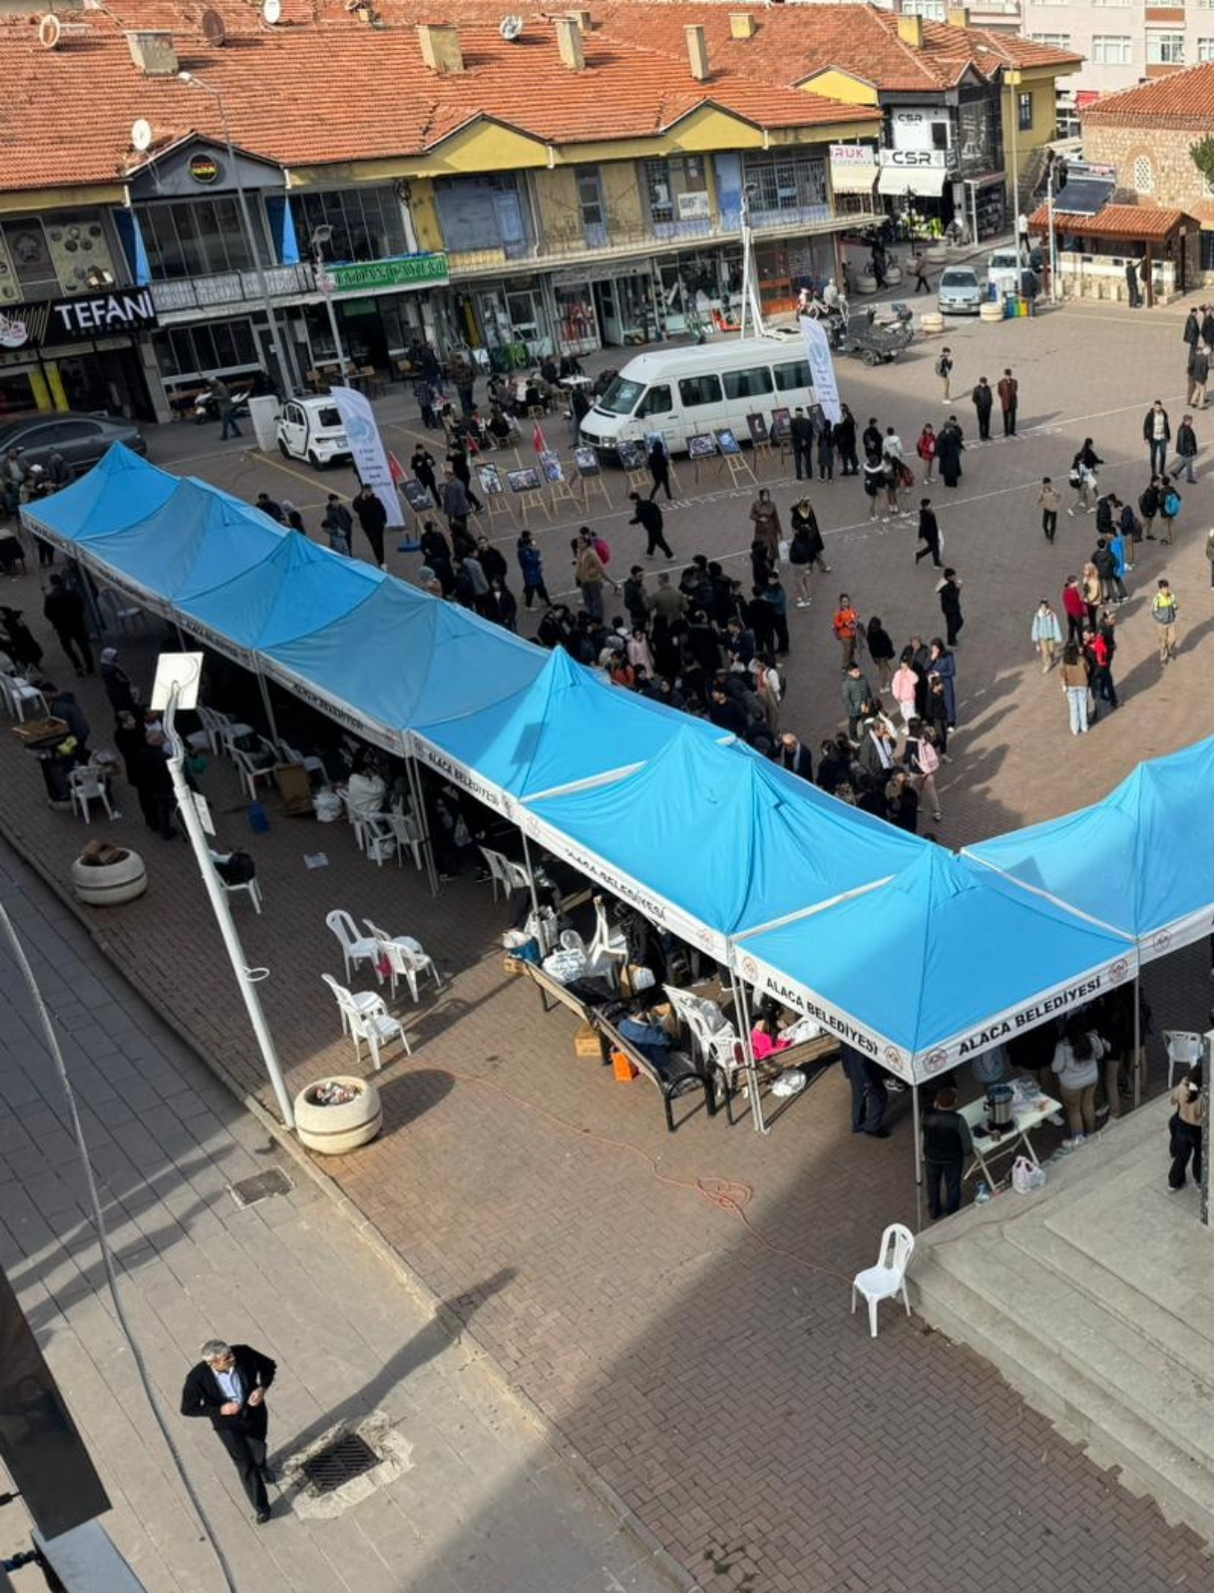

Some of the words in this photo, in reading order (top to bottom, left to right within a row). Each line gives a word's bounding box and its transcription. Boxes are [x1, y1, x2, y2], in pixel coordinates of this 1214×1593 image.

[898, 113, 923, 122] CSR
[891, 151, 932, 165] CSR
[54, 290, 155, 331] TEFANI
[766, 976, 804, 1008] ALACA
[804, 1001, 879, 1056] BELEDİYESİ
[959, 1021, 1012, 1057] ALACA
[1015, 975, 1102, 1029] BELEDİYESİ
